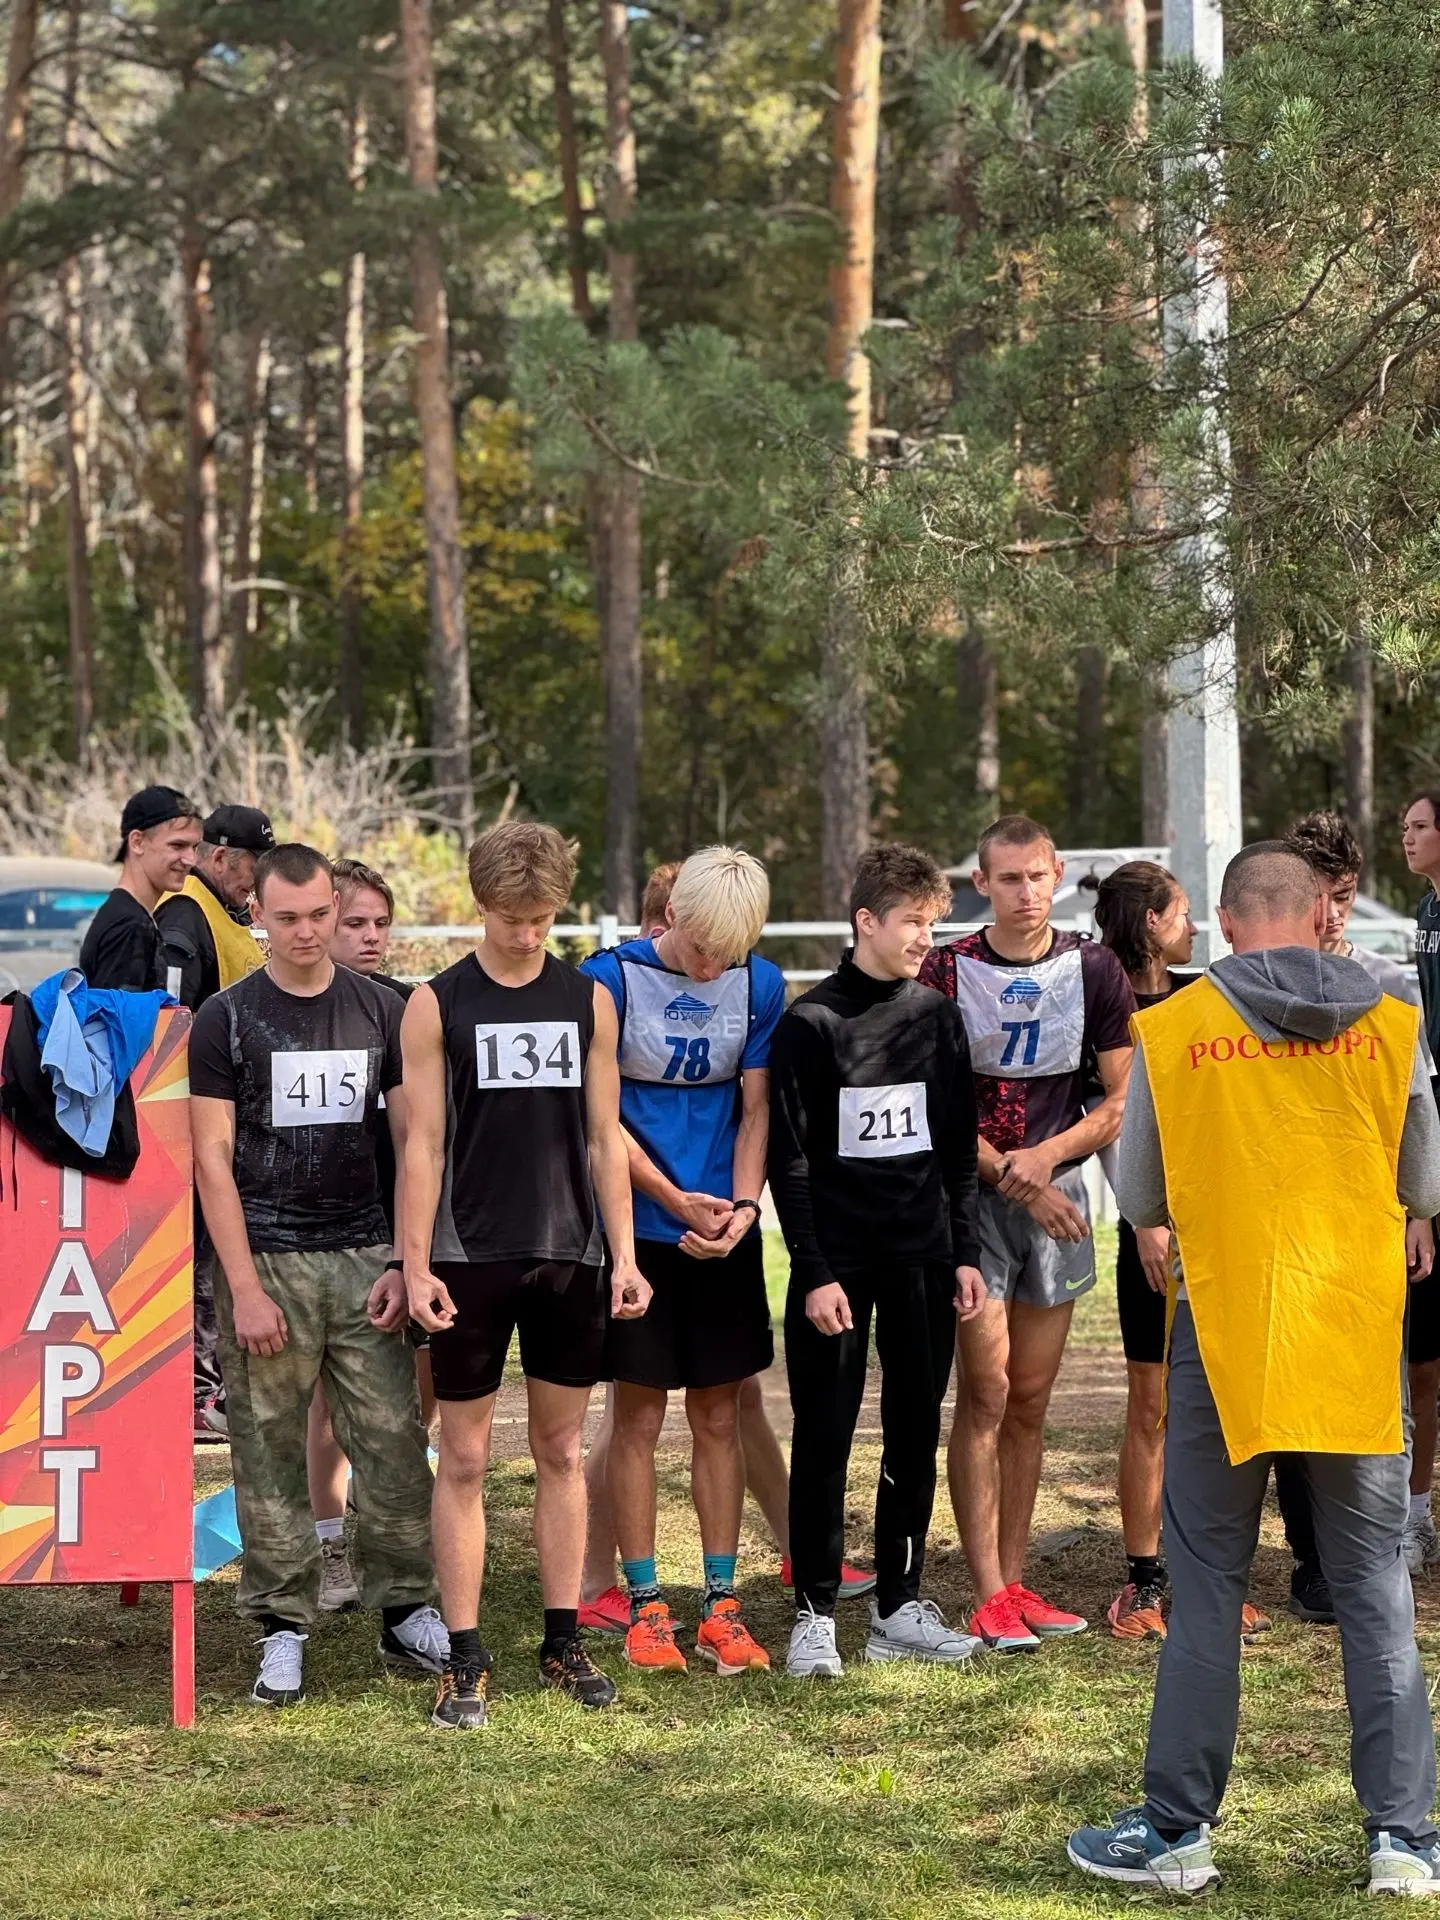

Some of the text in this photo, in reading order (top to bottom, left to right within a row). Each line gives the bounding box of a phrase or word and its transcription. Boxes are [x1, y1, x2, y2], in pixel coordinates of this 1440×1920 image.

[480, 1032, 573, 1080] 134
[661, 1035, 711, 1082] 78
[287, 1072, 357, 1108] 415
[858, 1106, 918, 1141] 211
